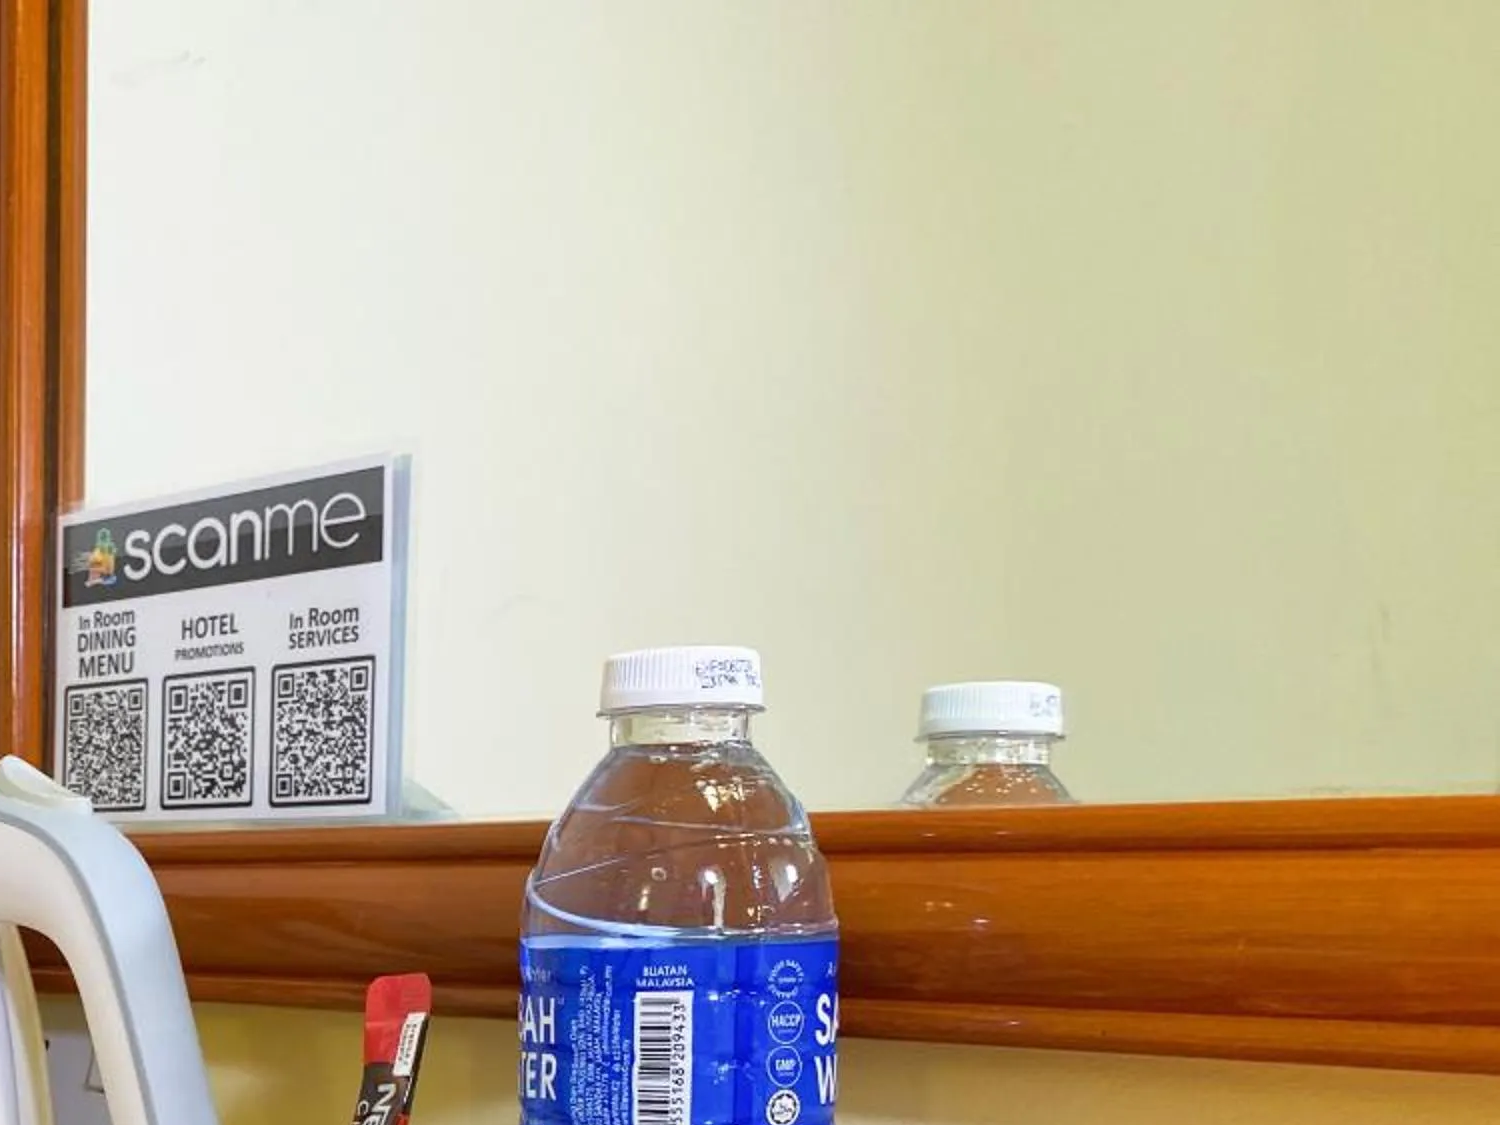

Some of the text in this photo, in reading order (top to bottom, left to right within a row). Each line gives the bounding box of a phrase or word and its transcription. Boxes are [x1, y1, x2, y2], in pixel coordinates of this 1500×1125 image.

[123, 492, 366, 581] scanme
[78, 610, 135, 630] In Room
[181, 613, 239, 640] HOTEL
[289, 607, 360, 630] In Room
[77, 626, 136, 652] DINING
[288, 625, 360, 650] SERVICES
[174, 641, 245, 661] PROMOTIONS
[79, 651, 135, 678] MENU
[635, 976, 695, 988] MALAYSIA
[642, 964, 688, 977] BUATAN
[771, 1014, 801, 1028] HACCP
